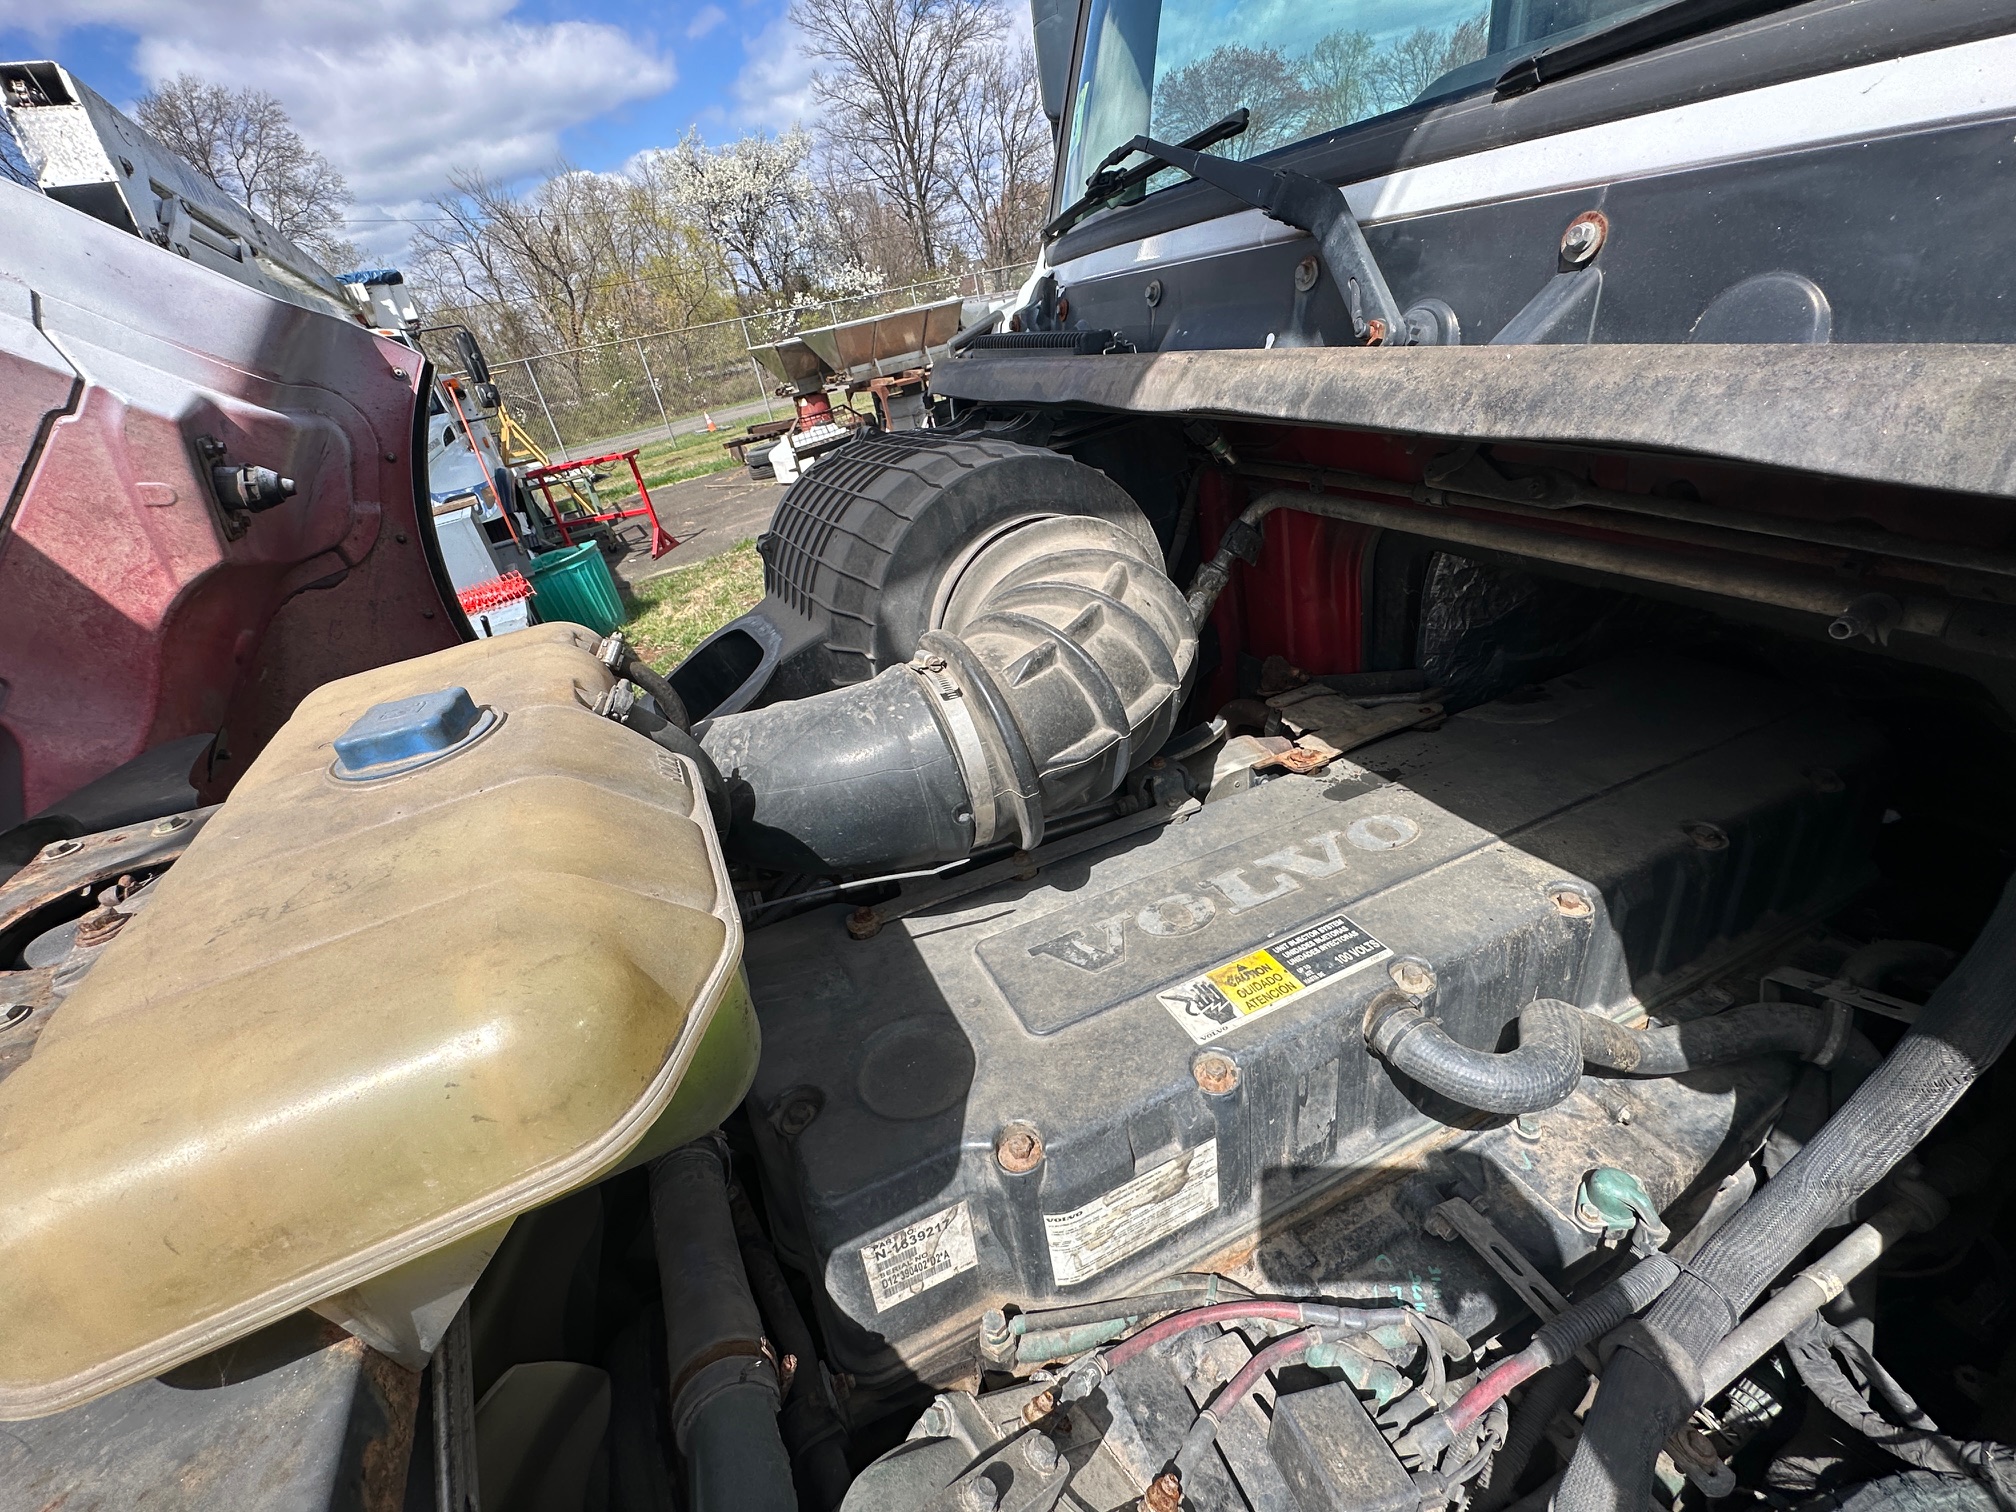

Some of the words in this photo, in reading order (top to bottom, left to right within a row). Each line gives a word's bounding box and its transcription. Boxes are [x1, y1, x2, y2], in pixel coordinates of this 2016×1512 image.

[1028, 814, 1419, 973] VOLVO
[1272, 944, 1289, 954] UNIT
[1287, 929, 1320, 947] INJECTOR
[1318, 919, 1345, 934] SYSTEM
[1282, 941, 1316, 959] UNIDADES
[1313, 925, 1350, 944] INJETORAS
[1286, 947, 1321, 966] UNIDADES
[1318, 930, 1360, 952] INYECTORAS
[1334, 952, 1354, 965] 100
[1350, 939, 1381, 958] VOLTS
[1226, 963, 1273, 987] CAUTION
[1236, 973, 1283, 999] CUIDADO
[1245, 981, 1297, 1010] ATENCIÓN
[1200, 1025, 1229, 1041] VOLVO
[1046, 1211, 1083, 1223] VOLVO
